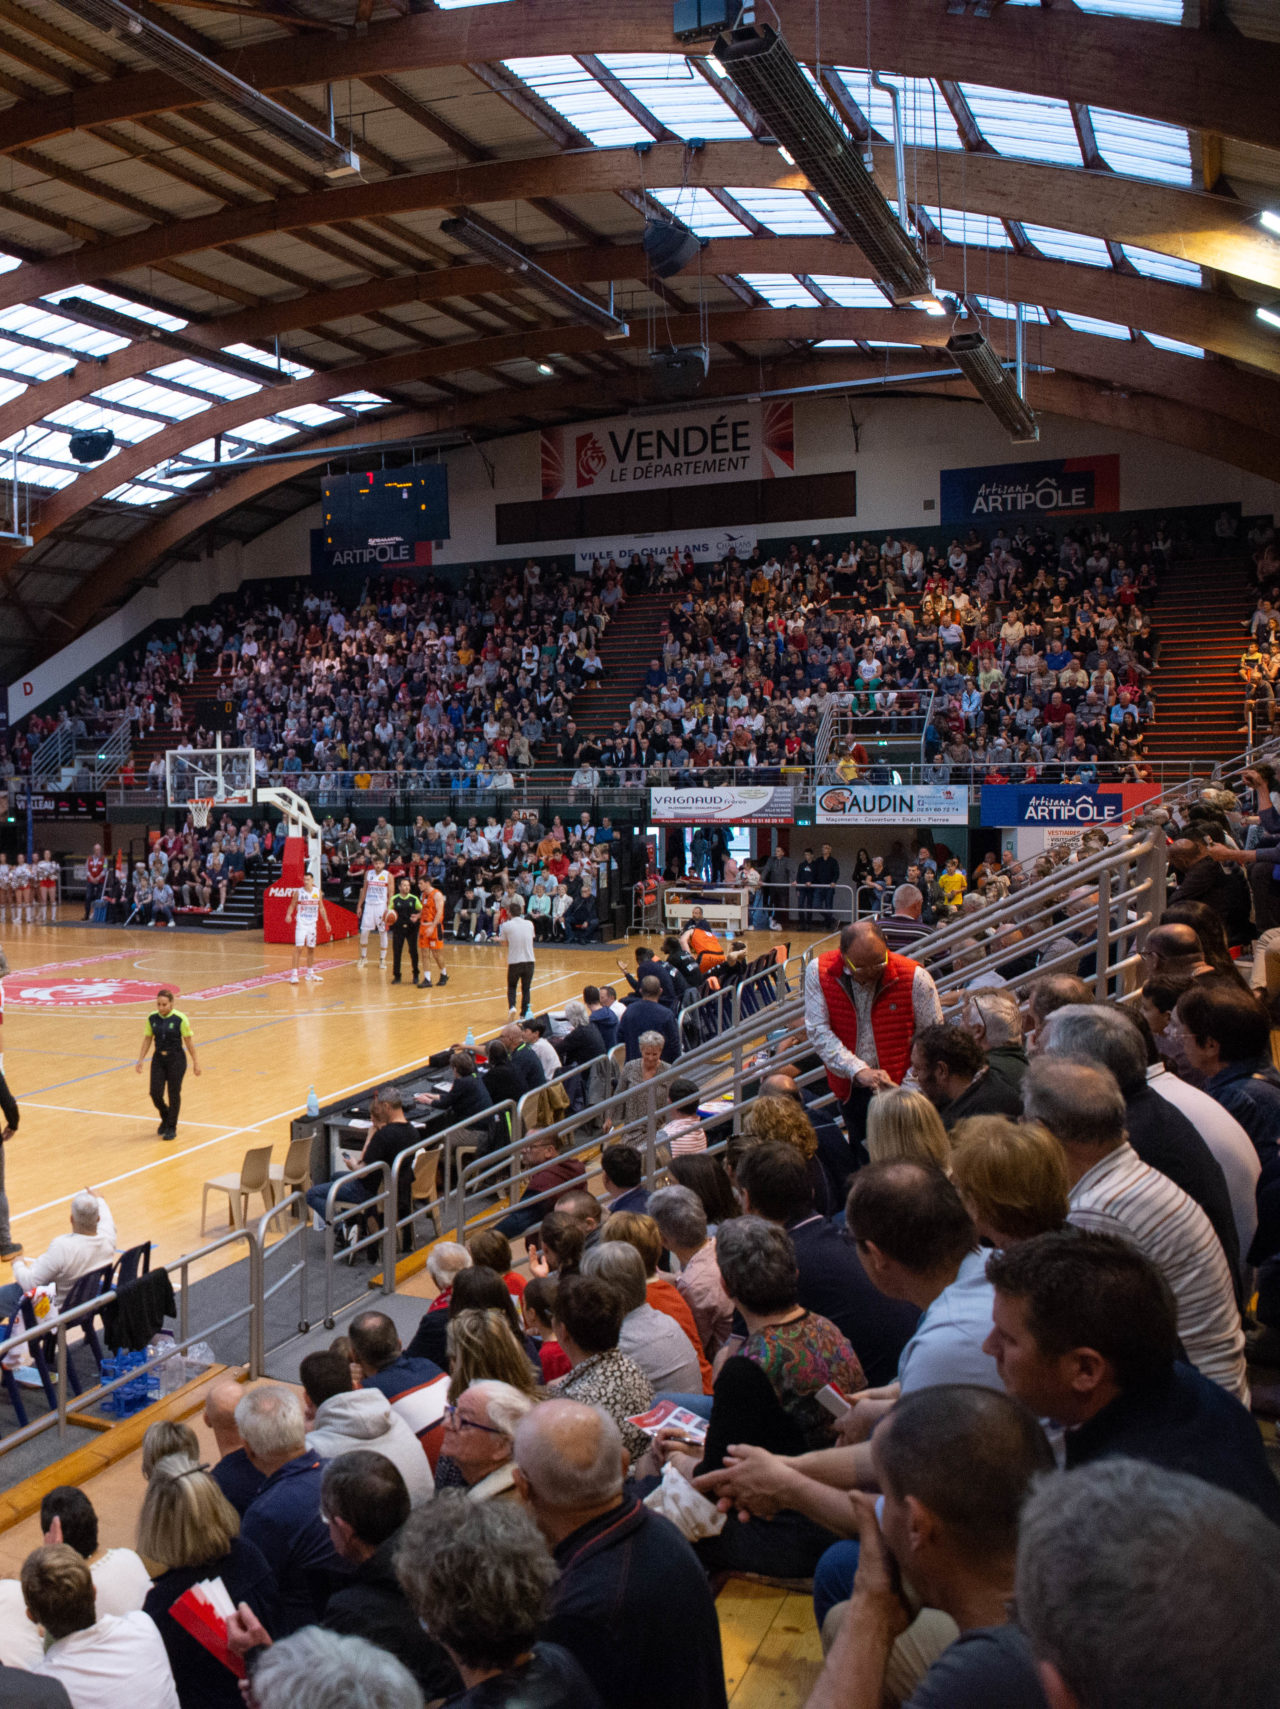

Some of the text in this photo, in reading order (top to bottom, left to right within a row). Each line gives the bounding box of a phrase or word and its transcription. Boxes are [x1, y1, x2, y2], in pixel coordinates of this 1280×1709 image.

[608, 415, 751, 464] VENDÉE
[610, 456, 750, 483] LE DÉPARTEMENT
[978, 482, 1030, 496] Artisans
[581, 551, 613, 561] VILLE
[619, 549, 635, 559] DE
[641, 543, 710, 557] CHALLANS
[23, 682, 33, 696] D
[654, 796, 723, 804] VRIGNAUD
[819, 788, 913, 814] GAUDIN
[1029, 796, 1071, 806] Artisans
